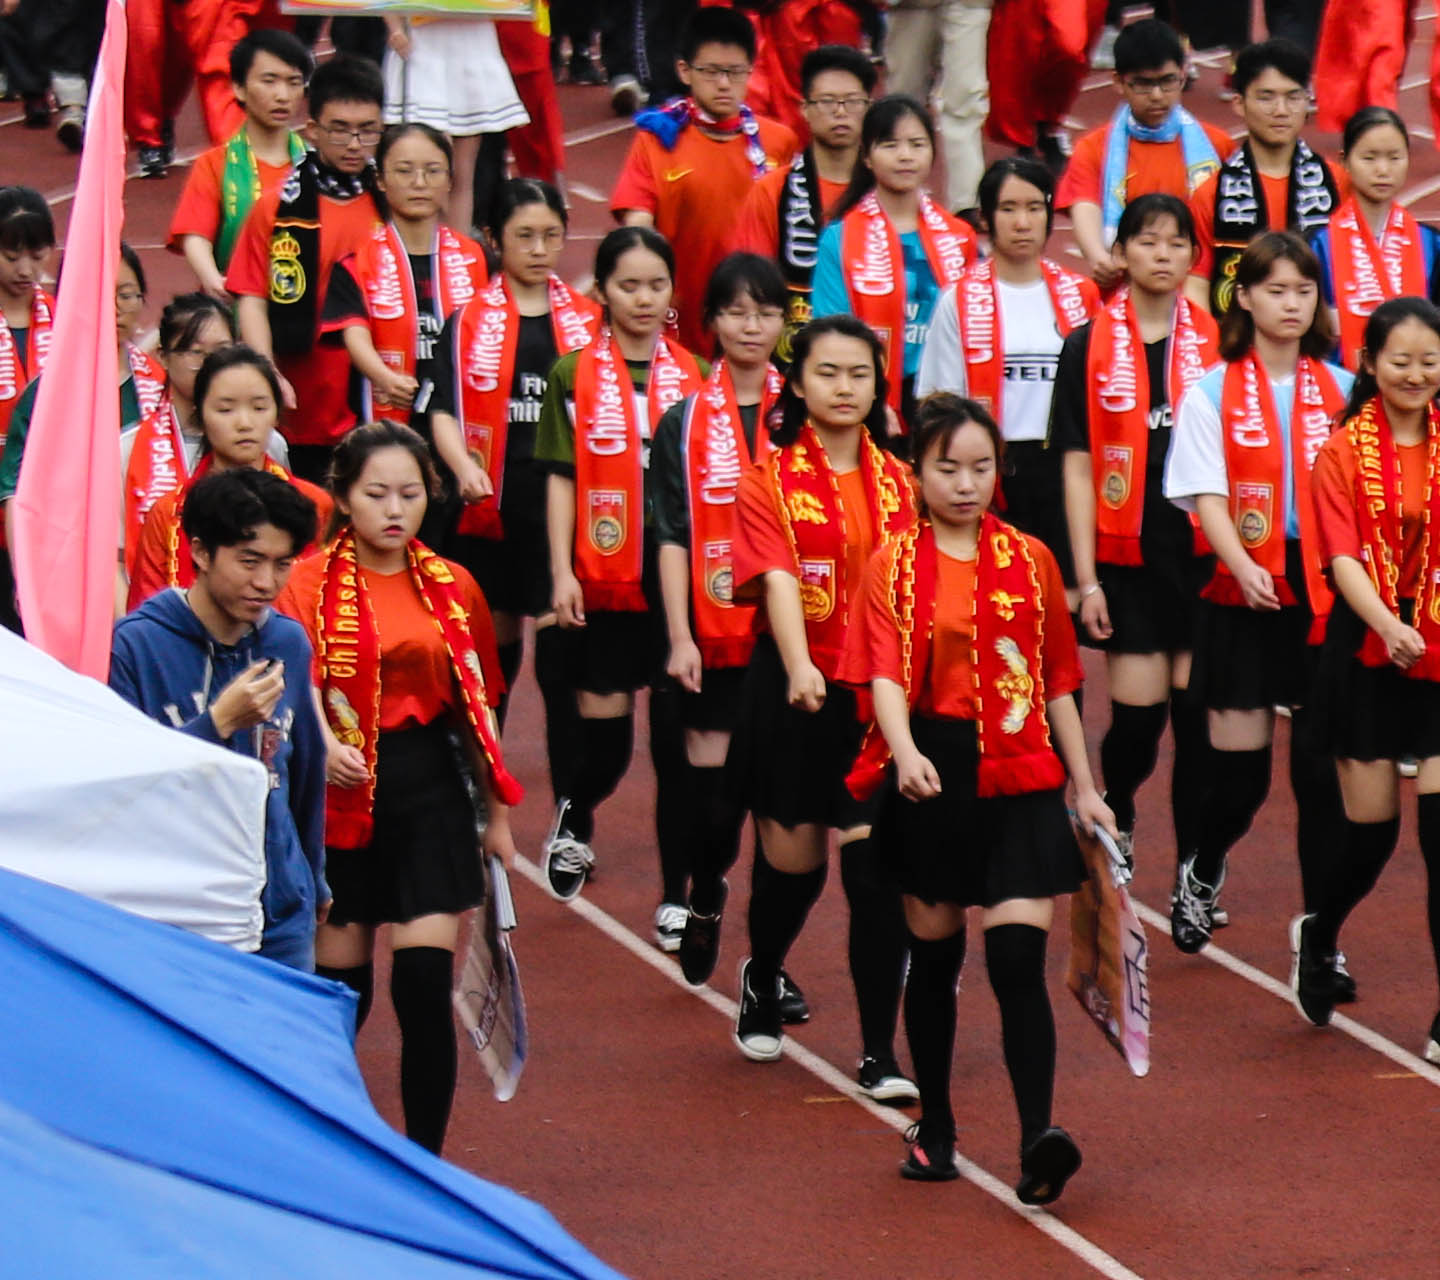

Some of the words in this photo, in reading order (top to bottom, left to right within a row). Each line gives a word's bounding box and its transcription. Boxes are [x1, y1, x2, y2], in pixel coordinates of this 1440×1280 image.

[467, 308, 508, 393] Chinese
[701, 410, 742, 505] Chinese
[705, 544, 732, 559] CF
